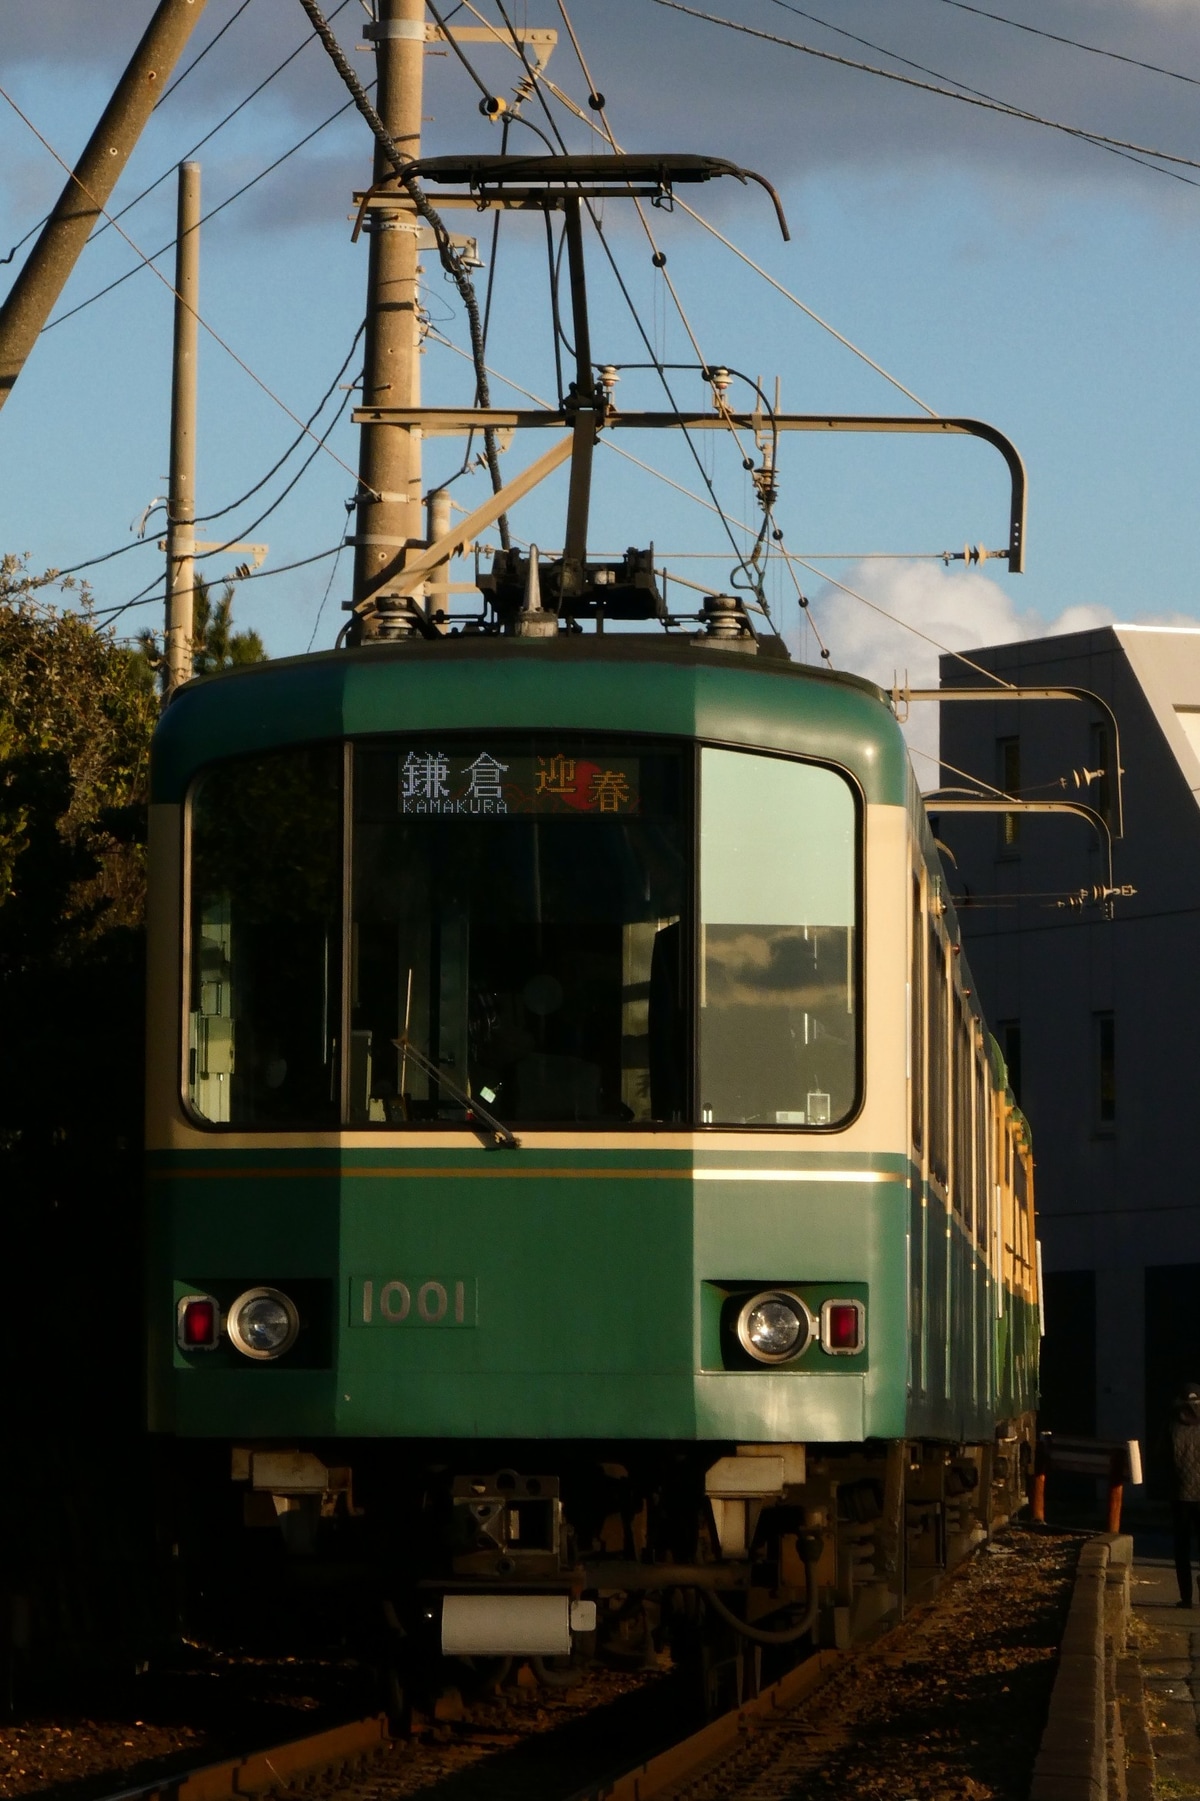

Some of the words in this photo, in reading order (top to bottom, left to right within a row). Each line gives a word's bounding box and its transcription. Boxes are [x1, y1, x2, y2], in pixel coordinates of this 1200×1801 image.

[402, 751, 510, 798] 鎌倉
[535, 753, 630, 813] 迎春
[402, 799, 508, 814] KAMAKURA
[363, 1280, 465, 1324] 1001
